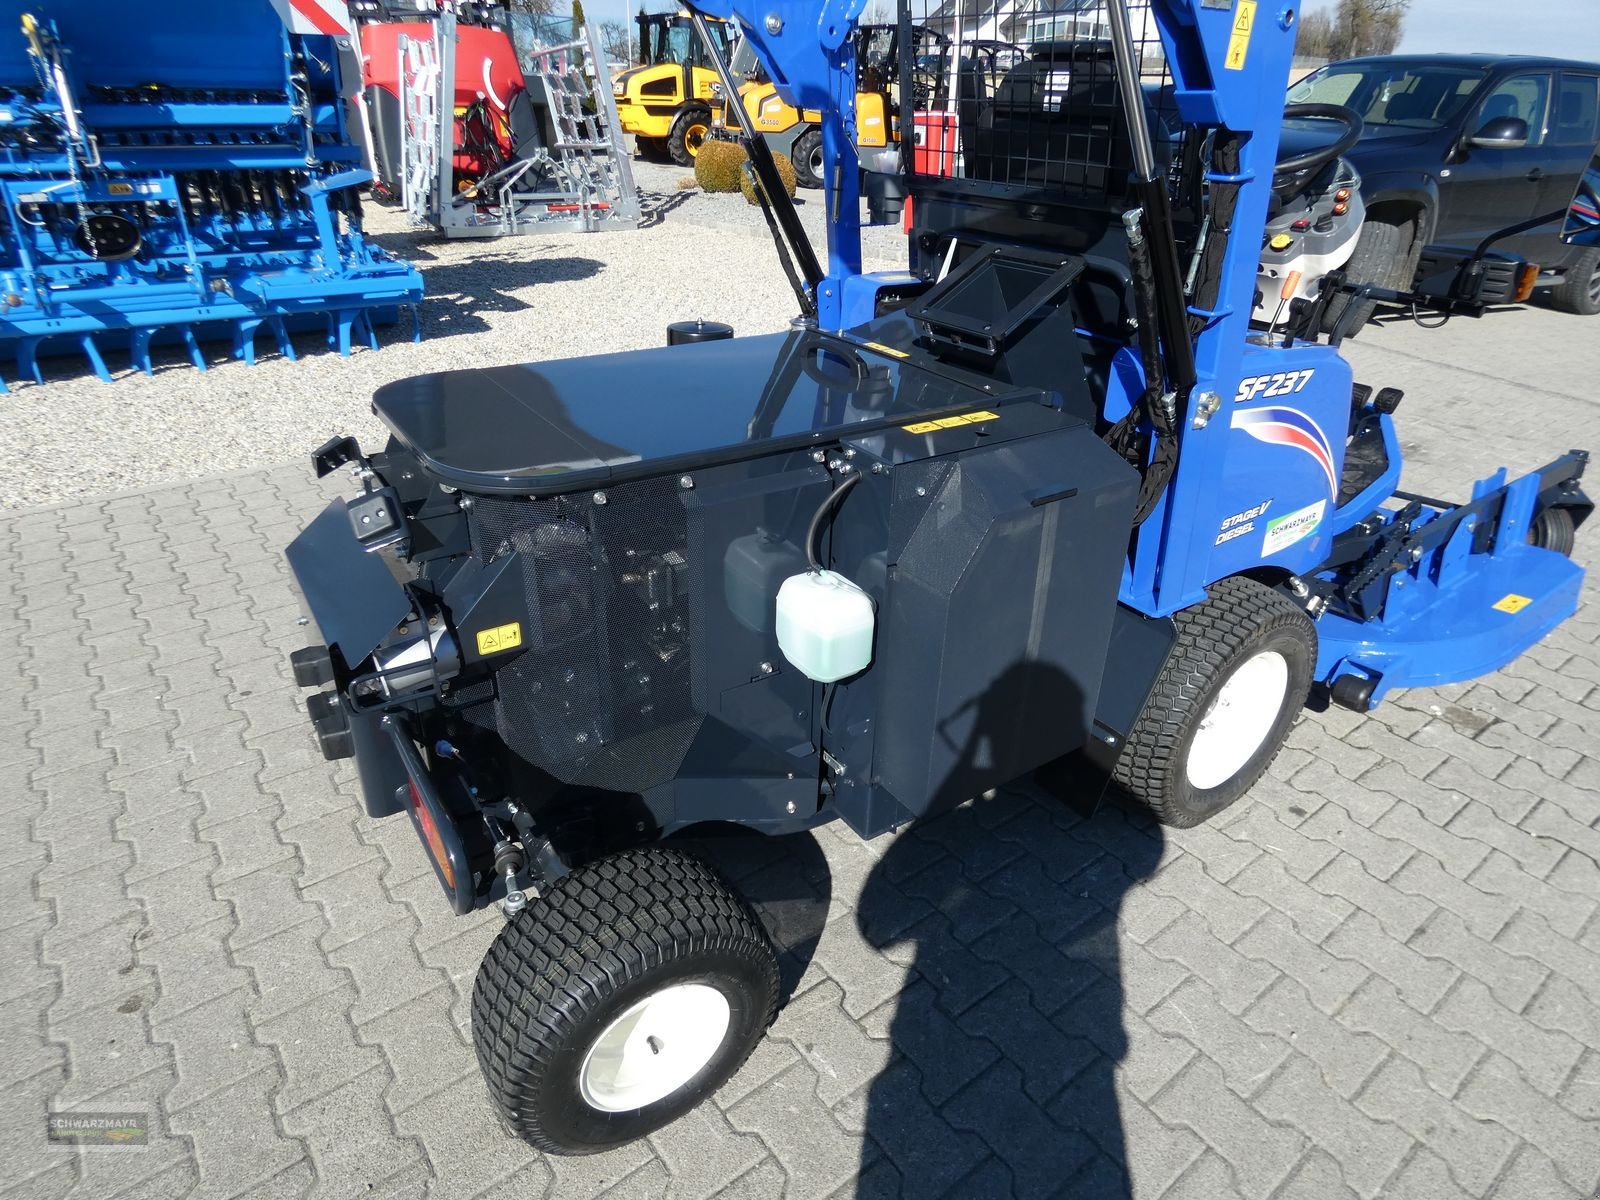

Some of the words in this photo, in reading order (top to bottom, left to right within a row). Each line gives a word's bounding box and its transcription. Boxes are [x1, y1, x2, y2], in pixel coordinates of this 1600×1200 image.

[1234, 368, 1315, 403] SF237
[1220, 506, 1261, 531] STAGE
[1271, 512, 1317, 537] SCHWARZMAYR
[1214, 521, 1256, 547] DIESEL
